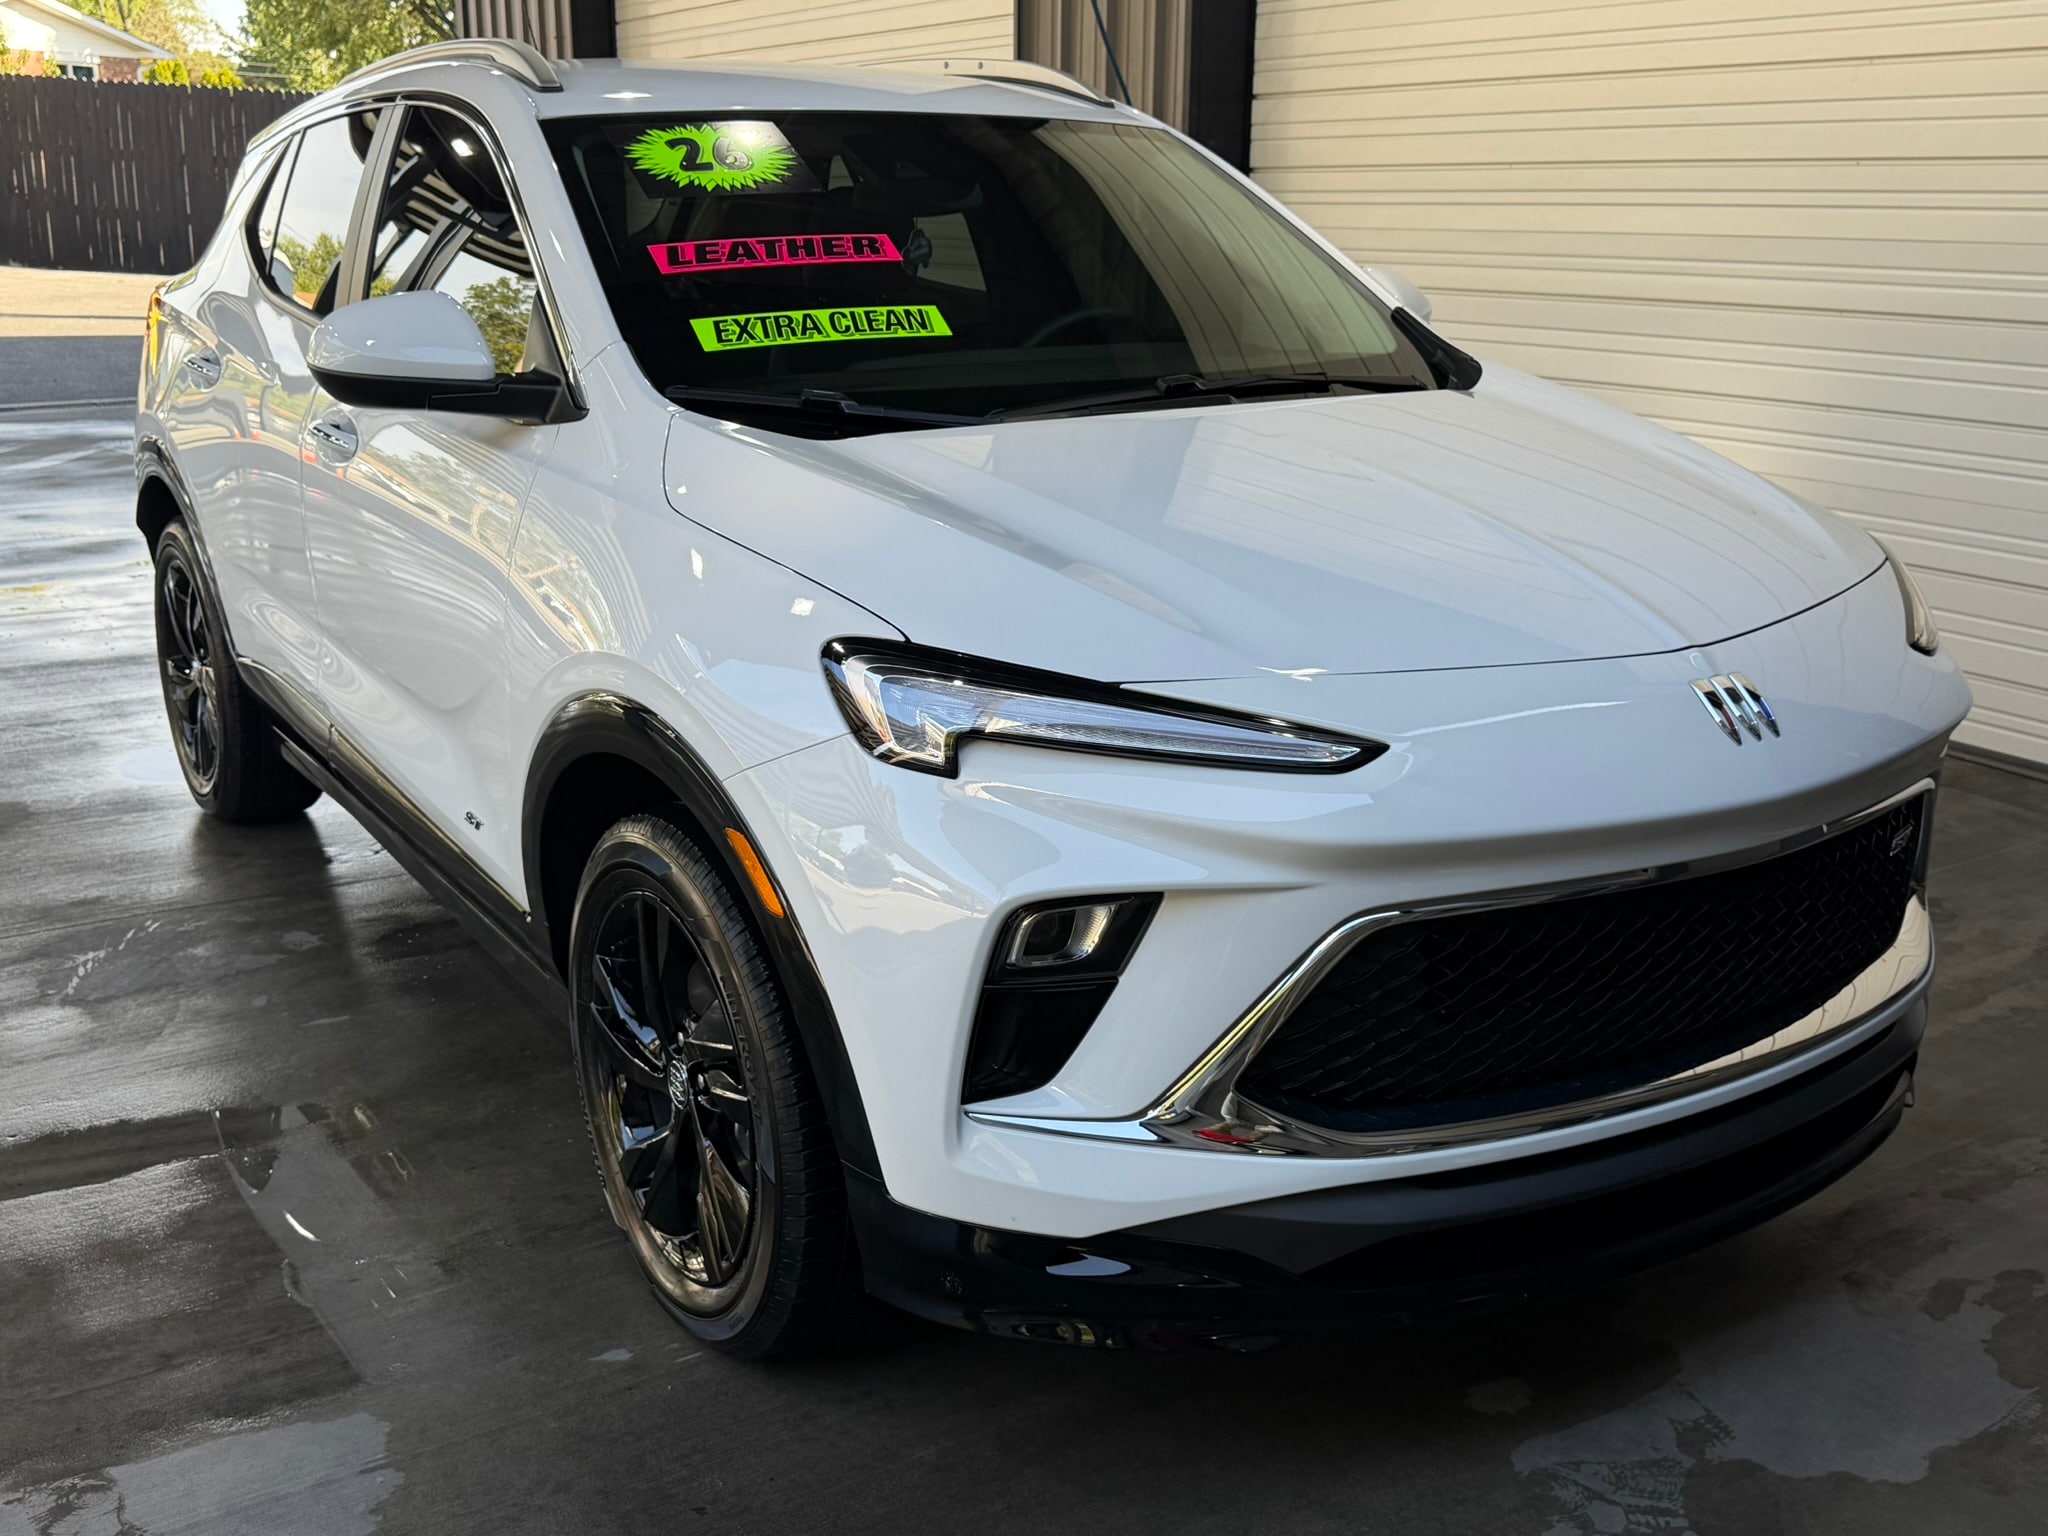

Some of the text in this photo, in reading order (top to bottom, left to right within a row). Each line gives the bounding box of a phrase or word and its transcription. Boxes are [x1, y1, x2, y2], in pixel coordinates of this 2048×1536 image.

[664, 137, 753, 172] 26
[666, 236, 886, 268] LEATHER
[713, 308, 932, 345] EXTRA CLEAN
